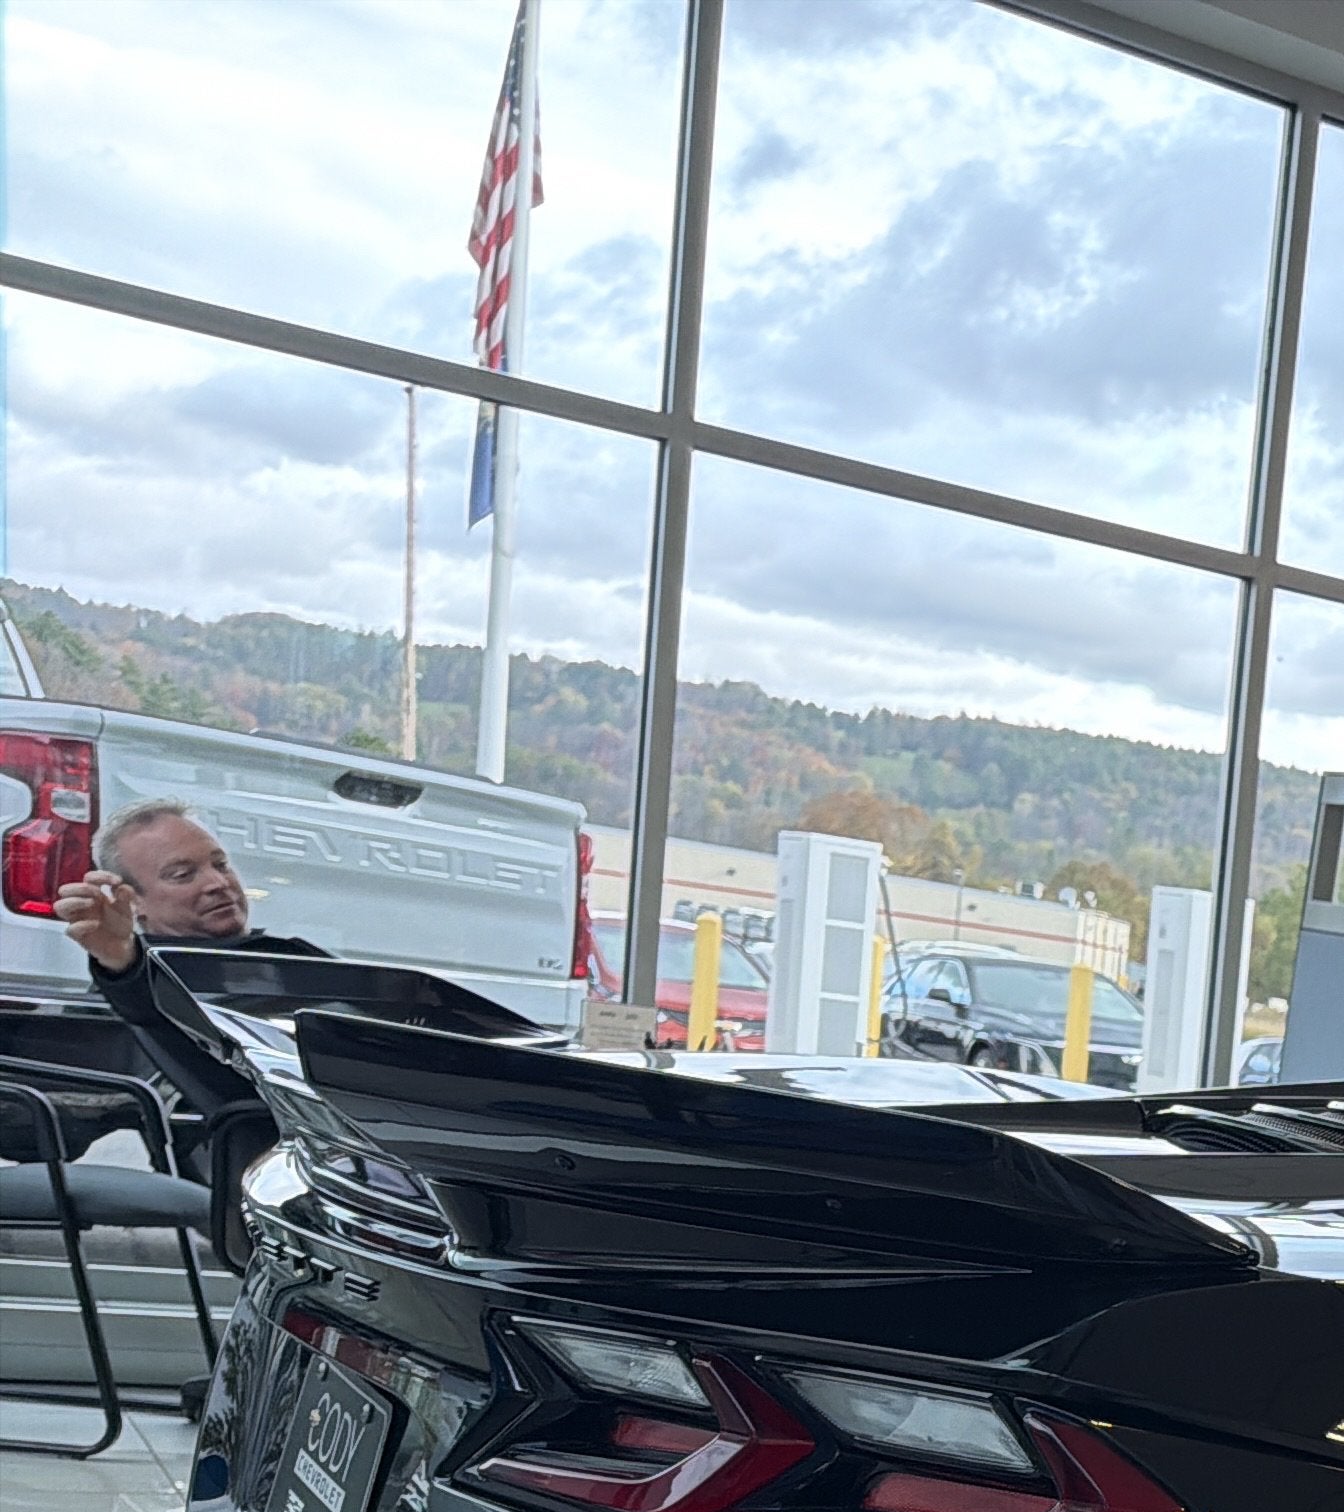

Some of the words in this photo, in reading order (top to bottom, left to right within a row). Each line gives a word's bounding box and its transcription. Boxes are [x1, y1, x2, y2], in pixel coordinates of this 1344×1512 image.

[207, 808, 563, 894] HEVROLET
[307, 1392, 366, 1483] CODY
[297, 1454, 342, 1510] CHEVROLET
